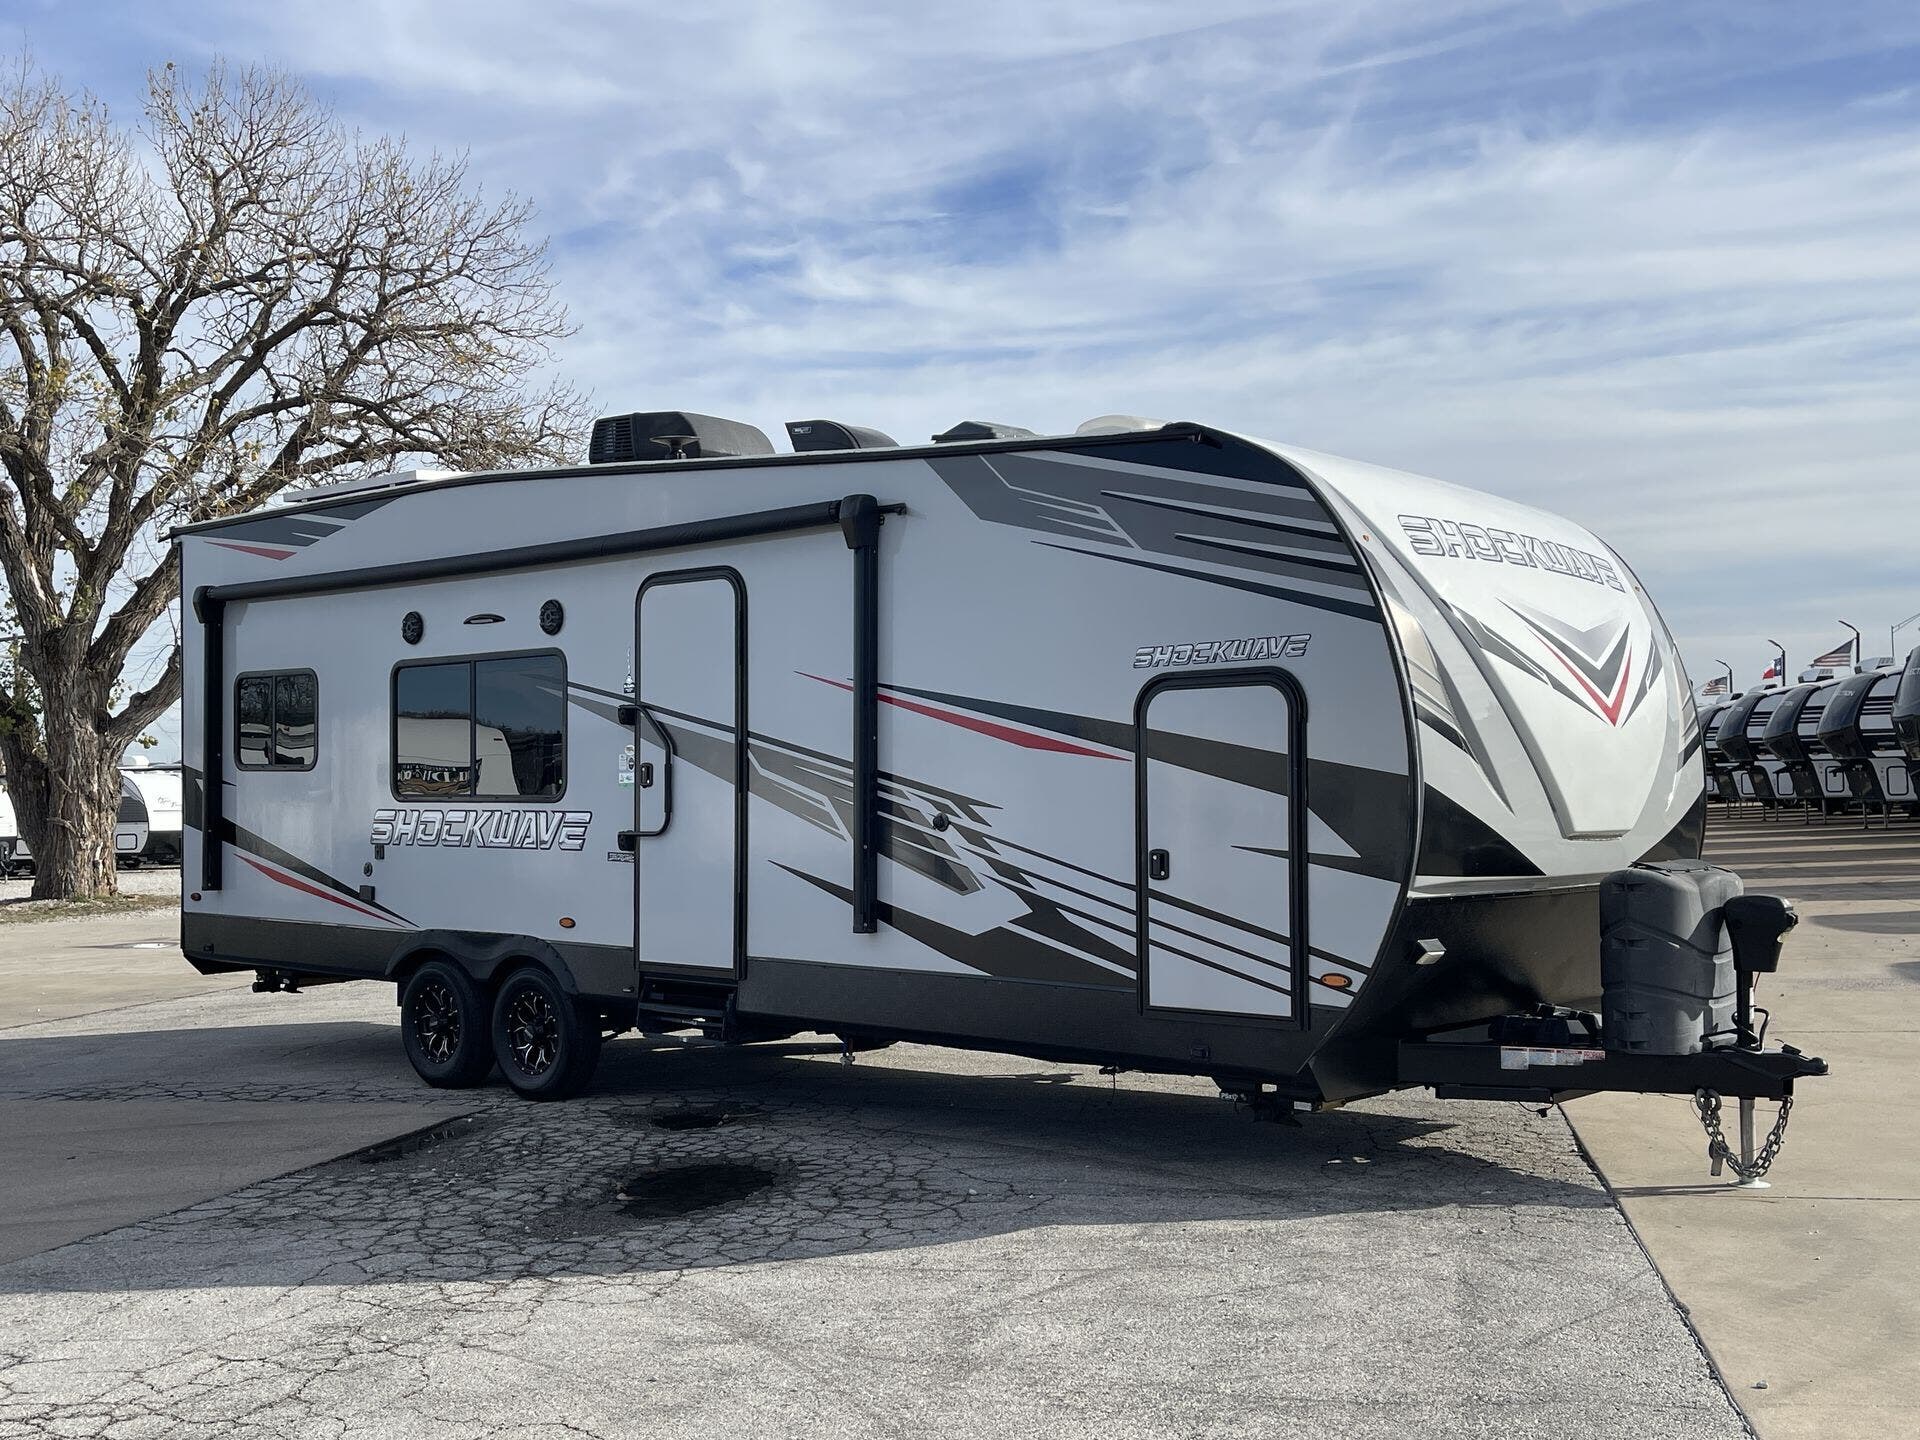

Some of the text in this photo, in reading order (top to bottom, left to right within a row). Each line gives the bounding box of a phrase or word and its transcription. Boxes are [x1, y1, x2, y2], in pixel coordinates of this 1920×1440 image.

[1397, 513, 1626, 593] SHOCKWAVE
[1132, 633, 1312, 669] SHOCKWAVE
[370, 808, 593, 851] SHOCKWAVE
